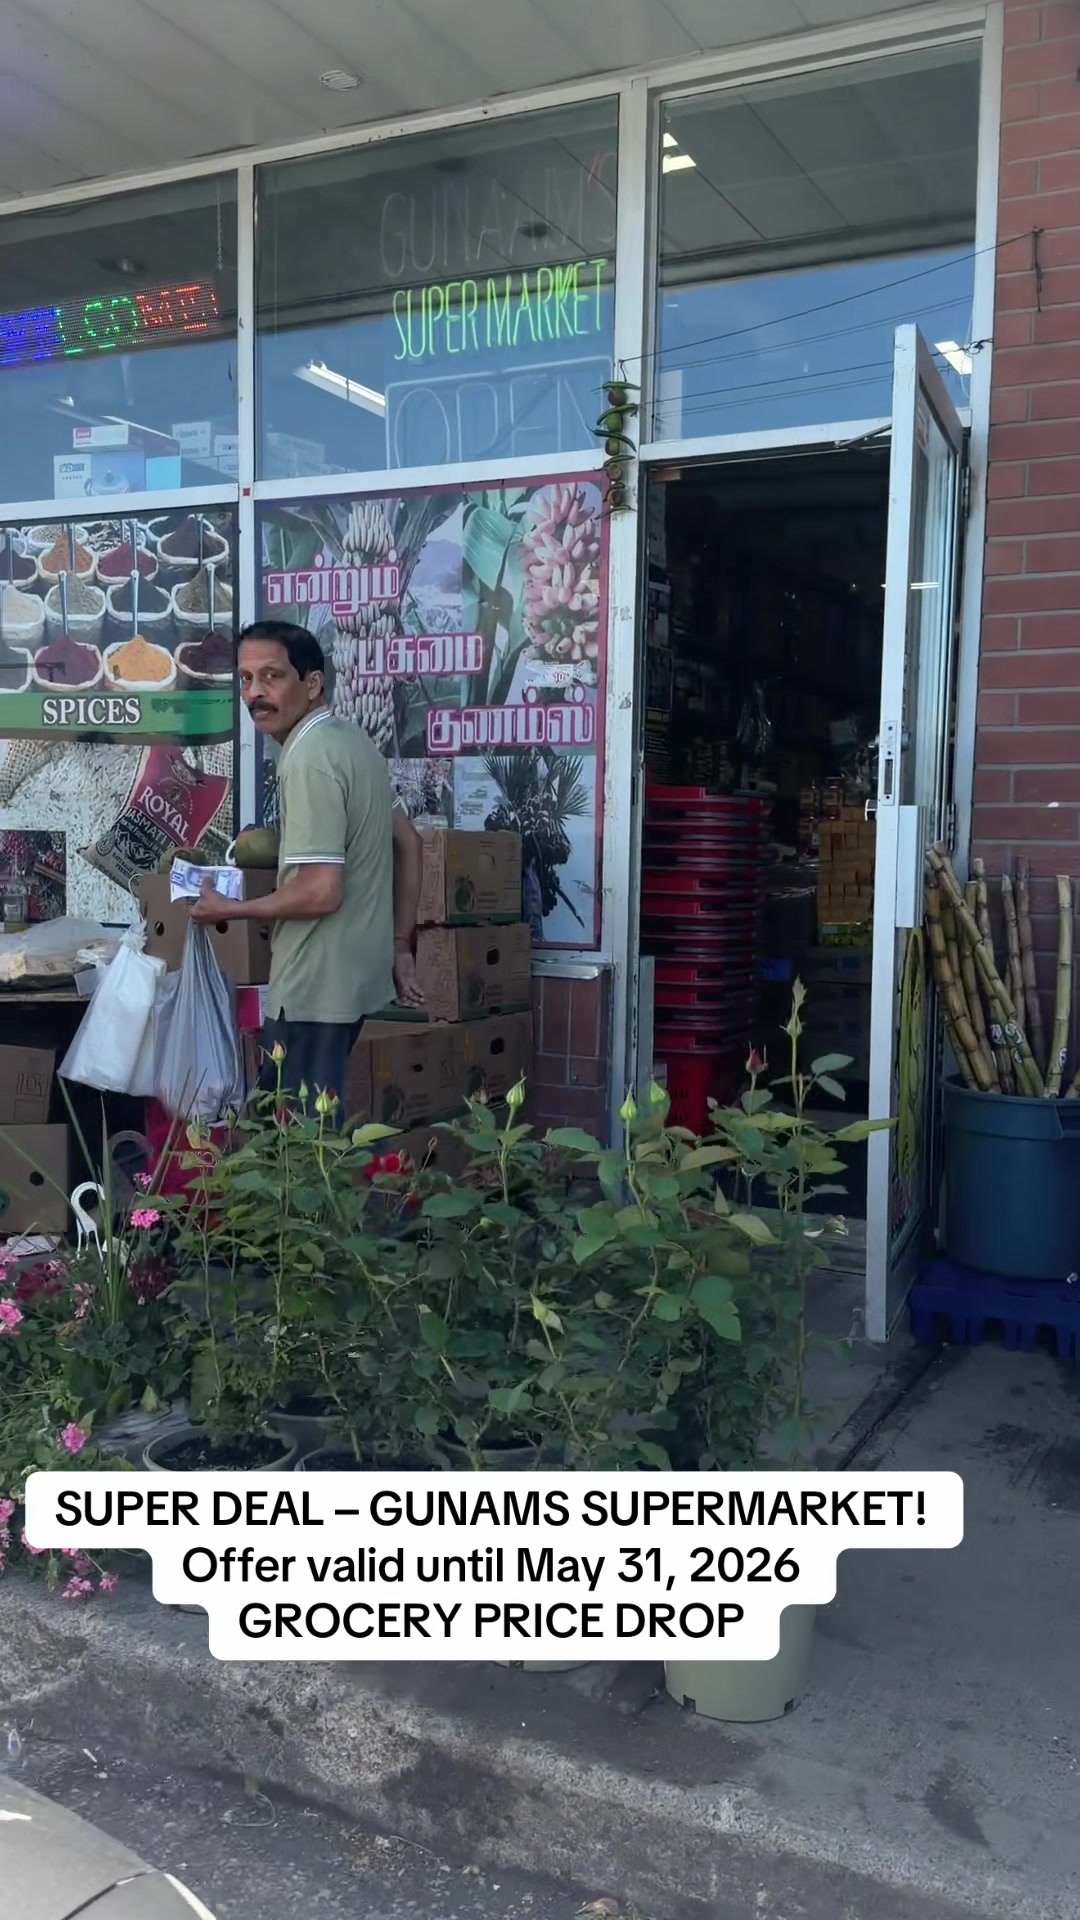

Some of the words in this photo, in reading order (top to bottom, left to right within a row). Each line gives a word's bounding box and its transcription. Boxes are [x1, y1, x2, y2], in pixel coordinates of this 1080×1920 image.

[392, 279, 479, 361] SUPER
[486, 258, 609, 347] MARKET
[267, 551, 400, 615] என்றும்
[358, 634, 483, 675] பசுமை
[43, 698, 140, 725] SPICES
[138, 786, 190, 841] ROYAL
